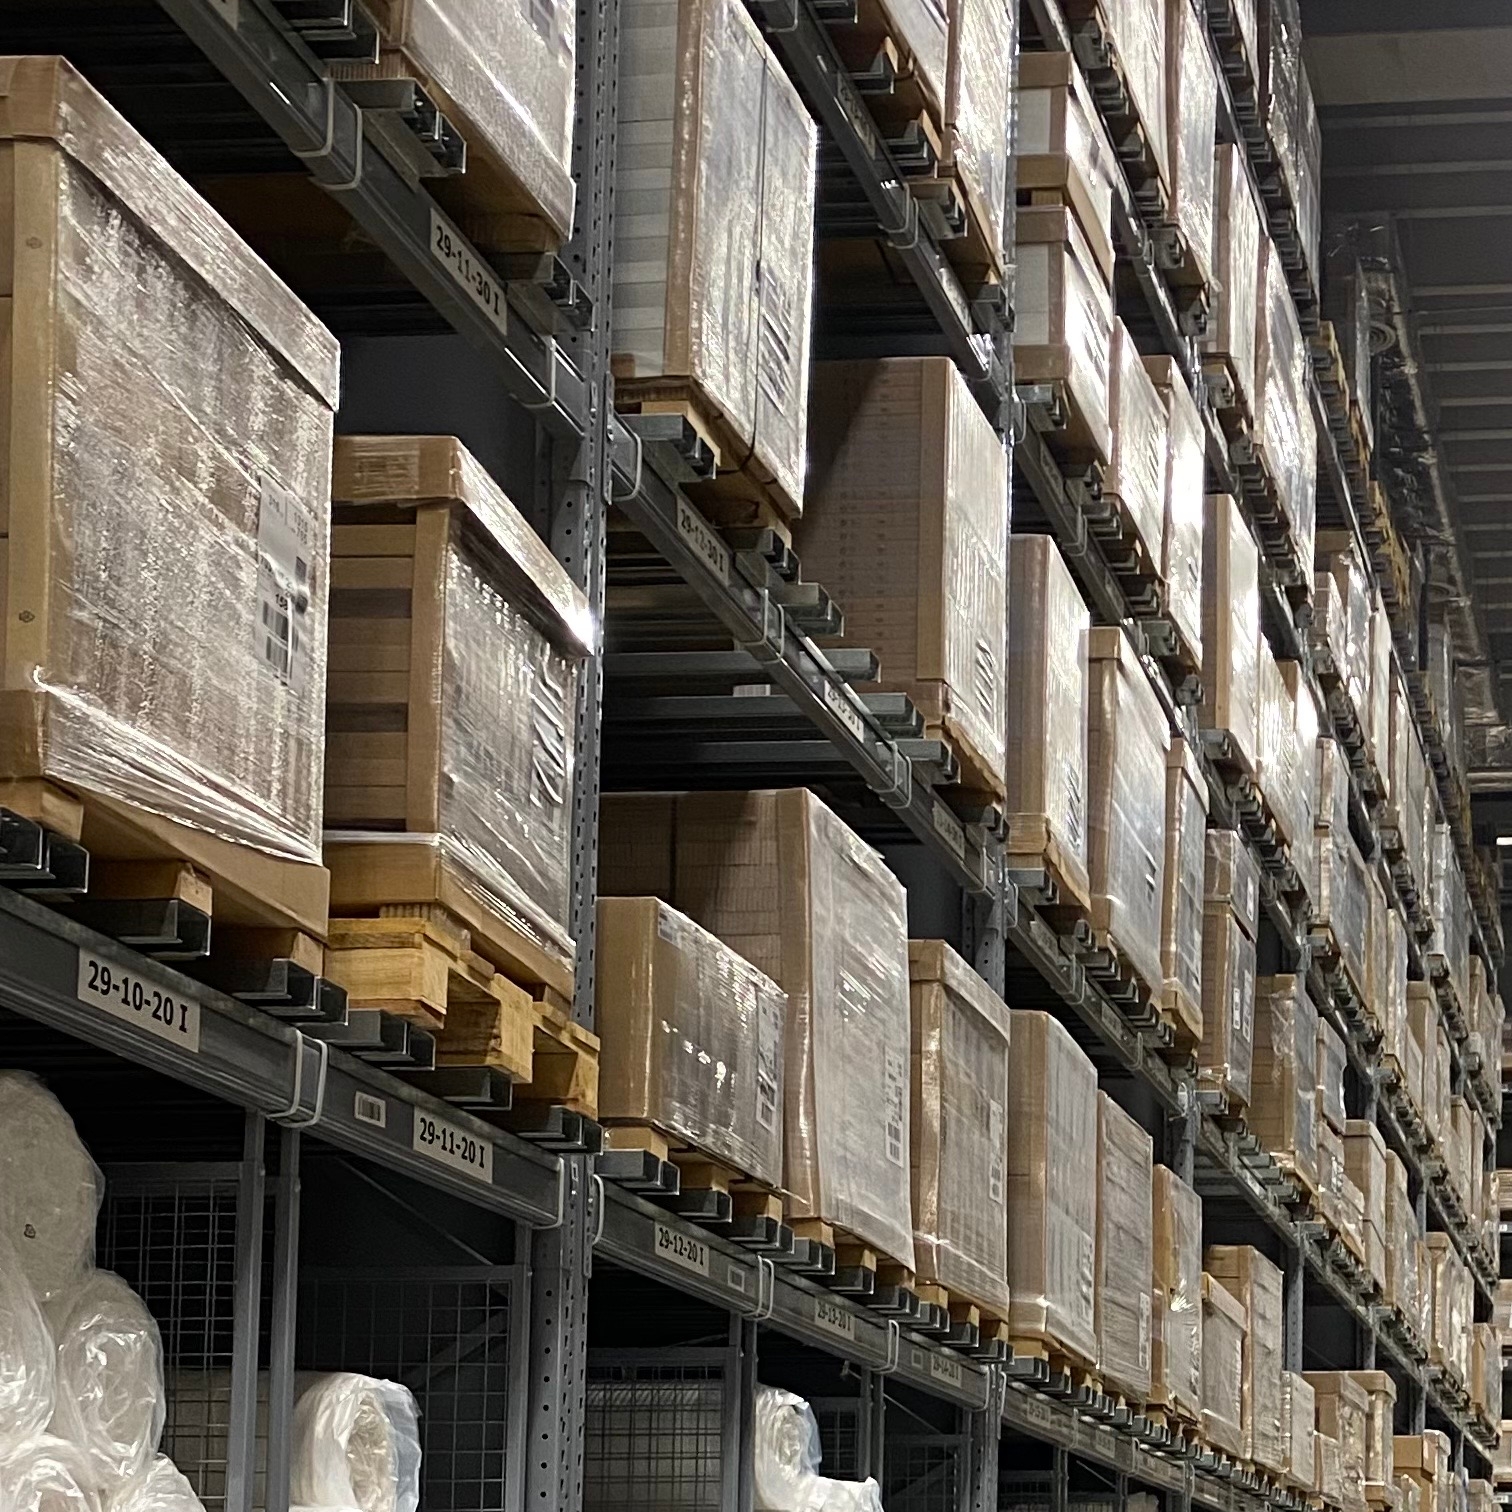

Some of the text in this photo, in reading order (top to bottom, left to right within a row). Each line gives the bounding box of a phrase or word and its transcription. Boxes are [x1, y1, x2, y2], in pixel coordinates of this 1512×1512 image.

[436, 225, 491, 305] 29-11-30
[88, 960, 188, 1034] 29-10-20 I
[419, 1117, 485, 1169] 29-11-20 I
[659, 1227, 698, 1263] 29-12-20
